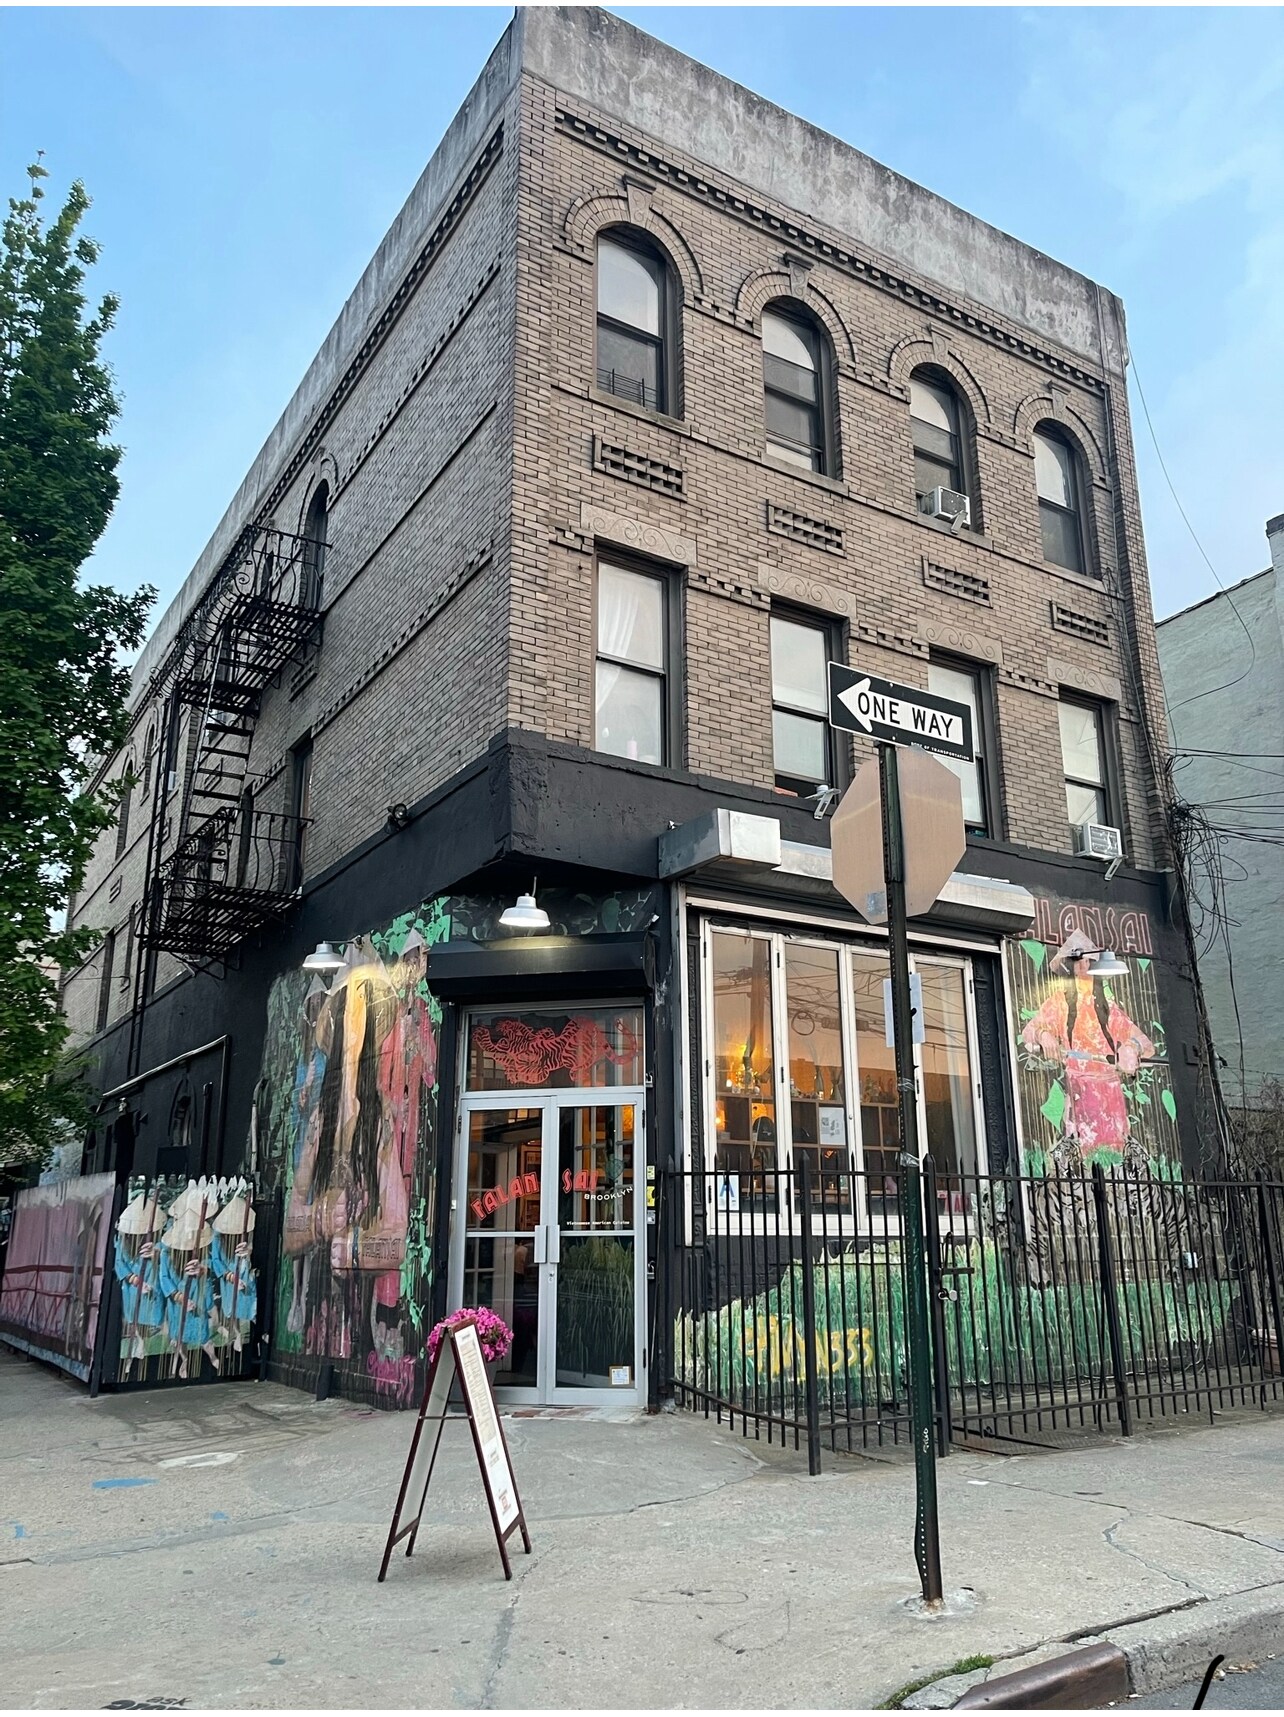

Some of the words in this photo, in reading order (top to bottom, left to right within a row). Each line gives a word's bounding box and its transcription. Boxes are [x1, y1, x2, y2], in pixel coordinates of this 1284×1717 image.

[858, 692, 901, 725] ONE
[911, 707, 954, 739] WAY
[931, 747, 970, 761] TRANSPORTATION
[1018, 897, 1153, 955] ALANSAI
[470, 1171, 540, 1221] TALAN
[562, 1168, 599, 1194] SAI
[584, 1186, 634, 1201] BROOKLYN
